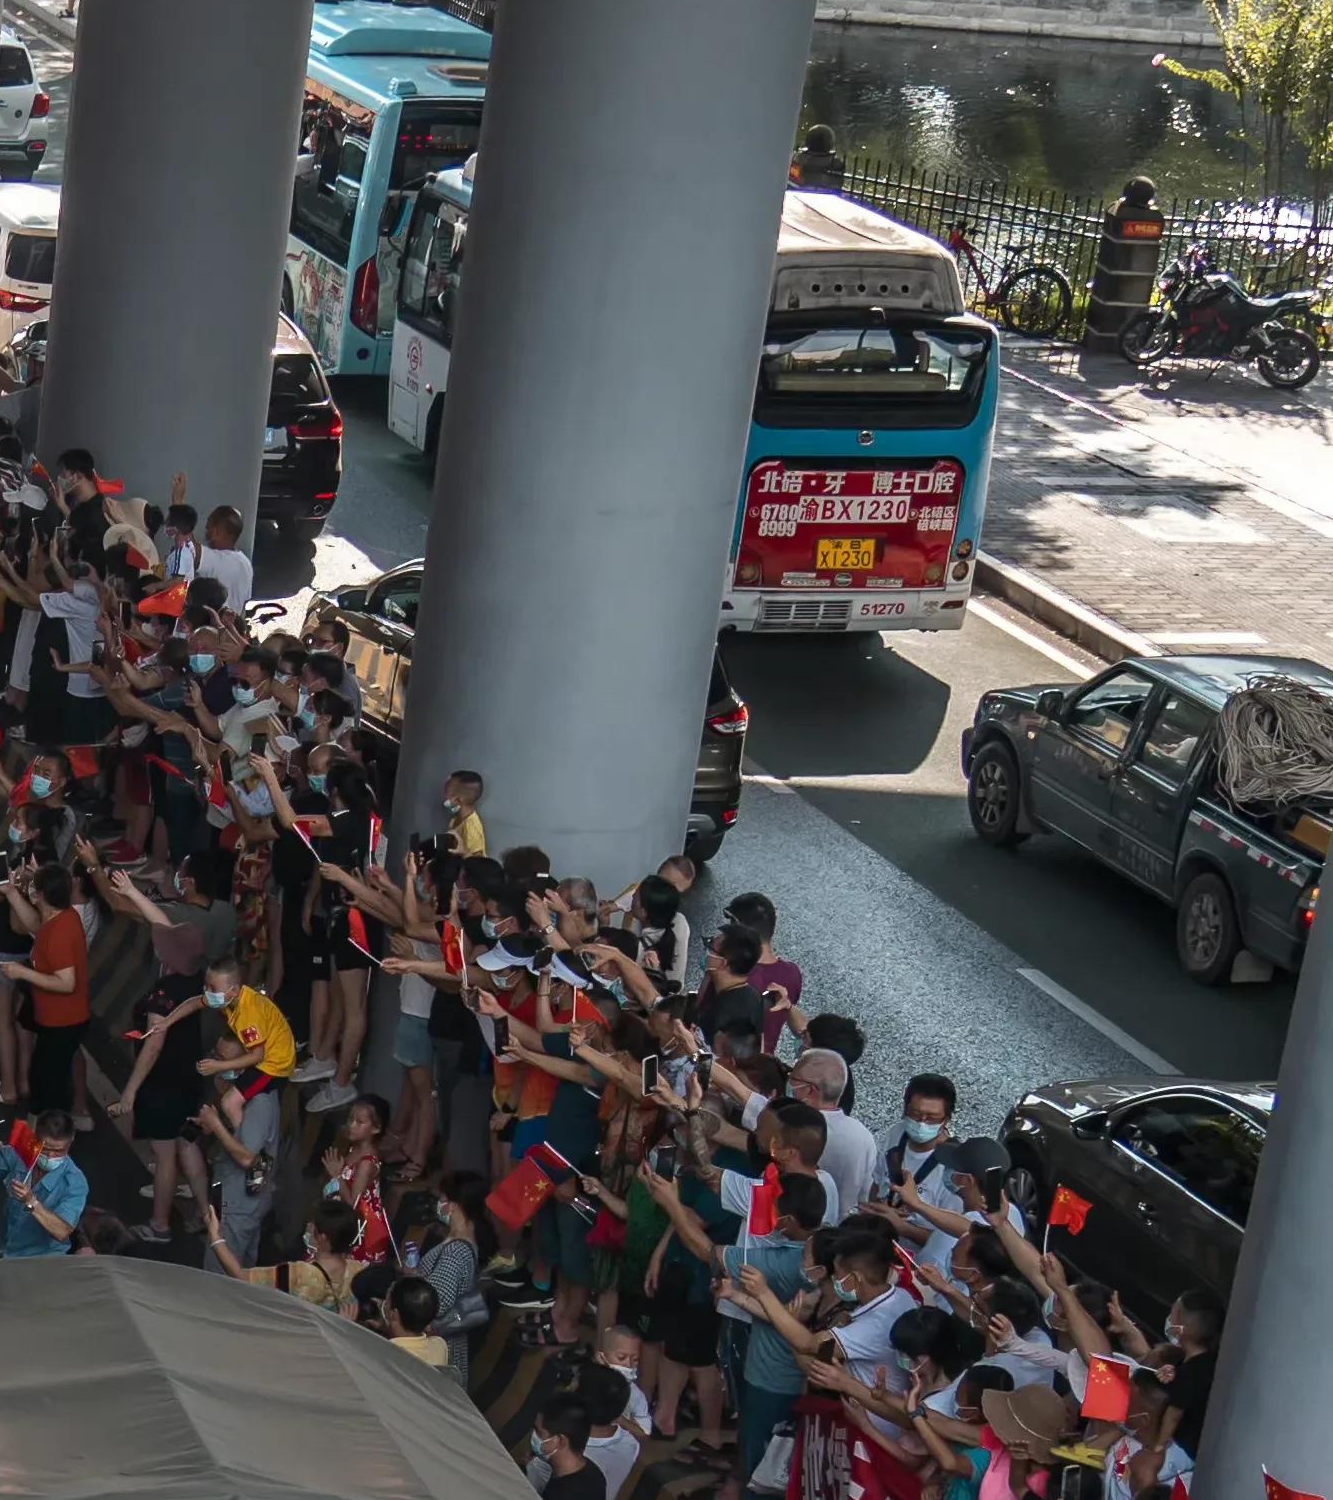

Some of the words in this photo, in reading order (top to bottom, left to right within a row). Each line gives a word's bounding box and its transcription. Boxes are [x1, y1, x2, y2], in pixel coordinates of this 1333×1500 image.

[872, 471, 956, 495] 博士口腔
[760, 504, 799, 522] 6780
[800, 497, 908, 522] 渝BX1230
[758, 520, 797, 537] 8999
[820, 551, 872, 567] X1230
[860, 603, 905, 616] 51270
